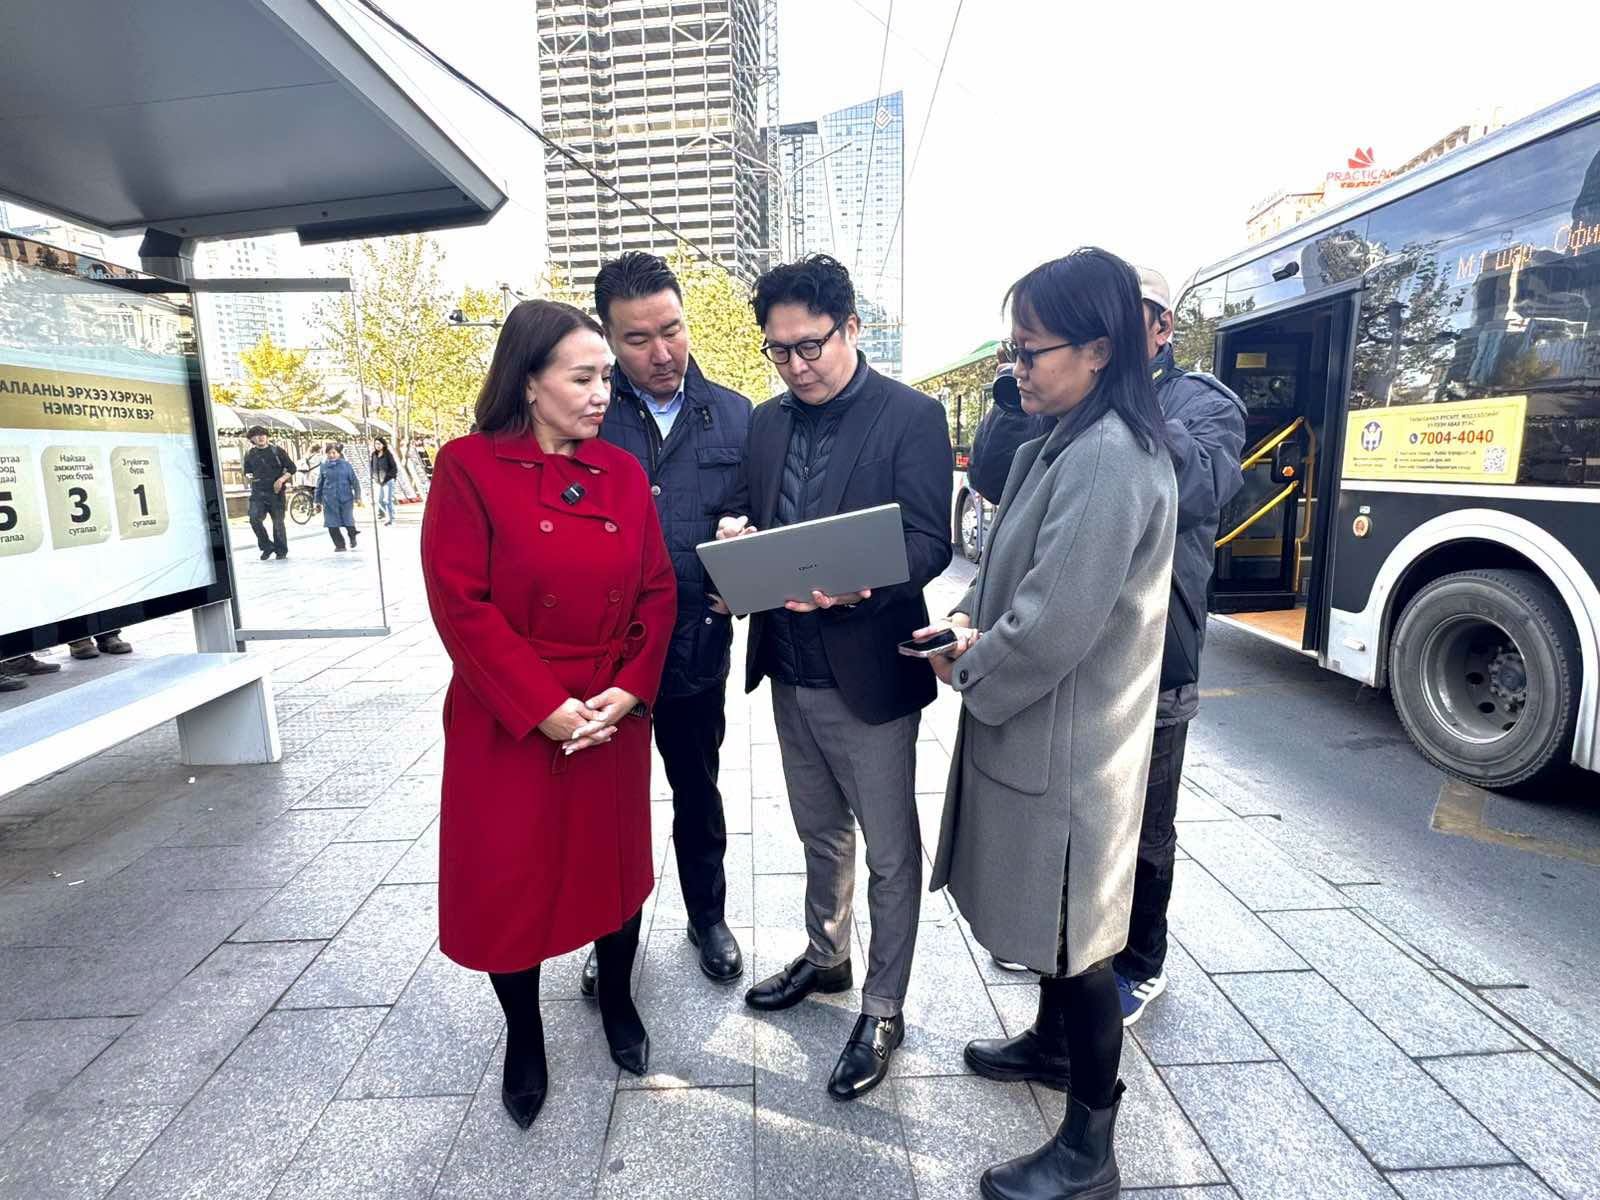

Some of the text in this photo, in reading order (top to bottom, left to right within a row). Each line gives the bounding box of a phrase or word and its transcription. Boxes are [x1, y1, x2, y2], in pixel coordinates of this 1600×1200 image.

[66, 386, 108, 401] ЭРХЭЭ
[109, 390, 152, 405] ХЭРХЭН
[136, 408, 154, 420] ВЭ?
[1420, 429, 1494, 444] 7004-4040
[68, 487, 92, 524] 3
[133, 484, 149, 517] 1
[69, 525, 97, 537] сугалаа
